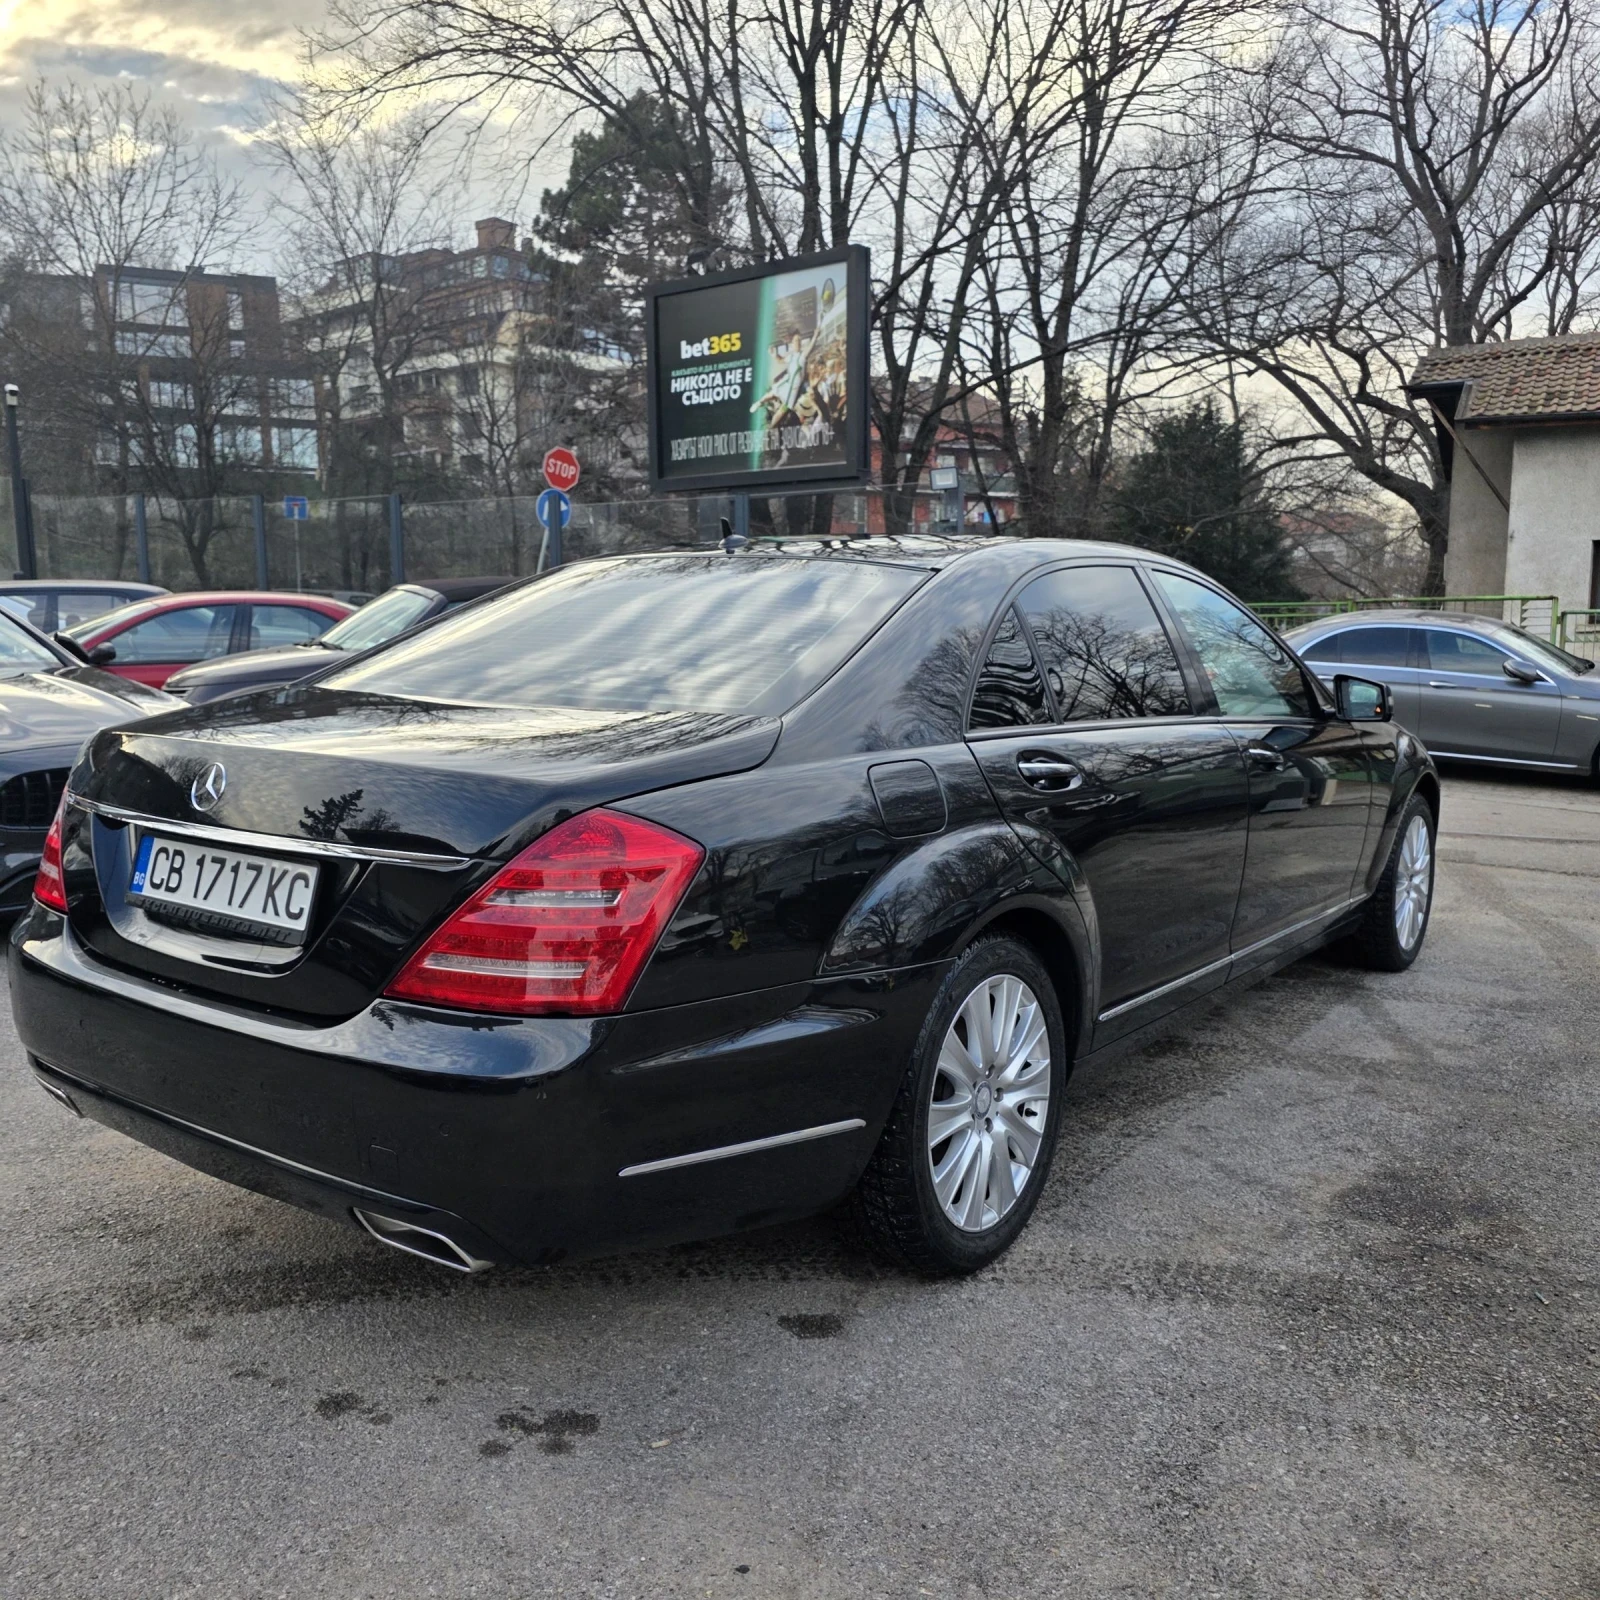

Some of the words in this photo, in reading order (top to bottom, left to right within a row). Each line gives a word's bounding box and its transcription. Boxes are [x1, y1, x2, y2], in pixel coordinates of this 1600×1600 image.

[680, 332, 742, 359] bet365
[670, 372, 723, 393] НИКОГА
[725, 368, 743, 385] НЕ
[744, 367, 753, 382] Е
[682, 384, 741, 406] СЪЩОТО
[547, 458, 576, 479] STOP
[133, 872, 145, 885] BG
